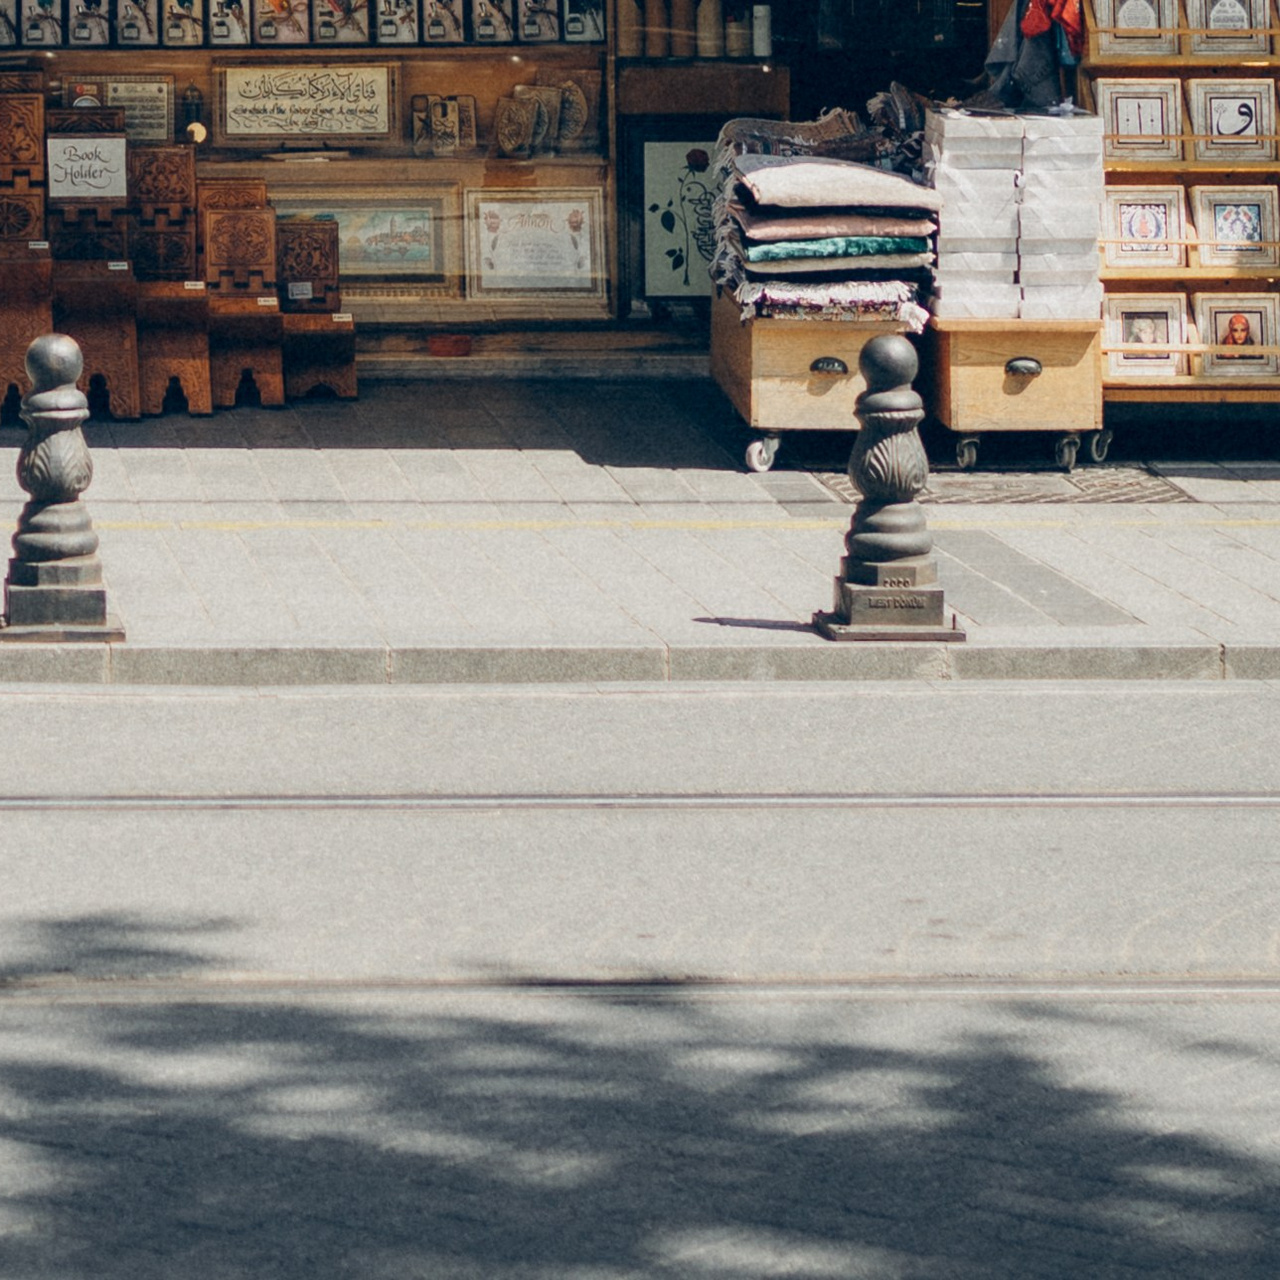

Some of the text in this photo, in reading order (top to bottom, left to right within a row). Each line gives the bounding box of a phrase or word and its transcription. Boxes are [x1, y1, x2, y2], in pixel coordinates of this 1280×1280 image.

[63, 145, 111, 163] Book
[53, 163, 119, 189] Holder
[882, 577, 913, 589] 2020
